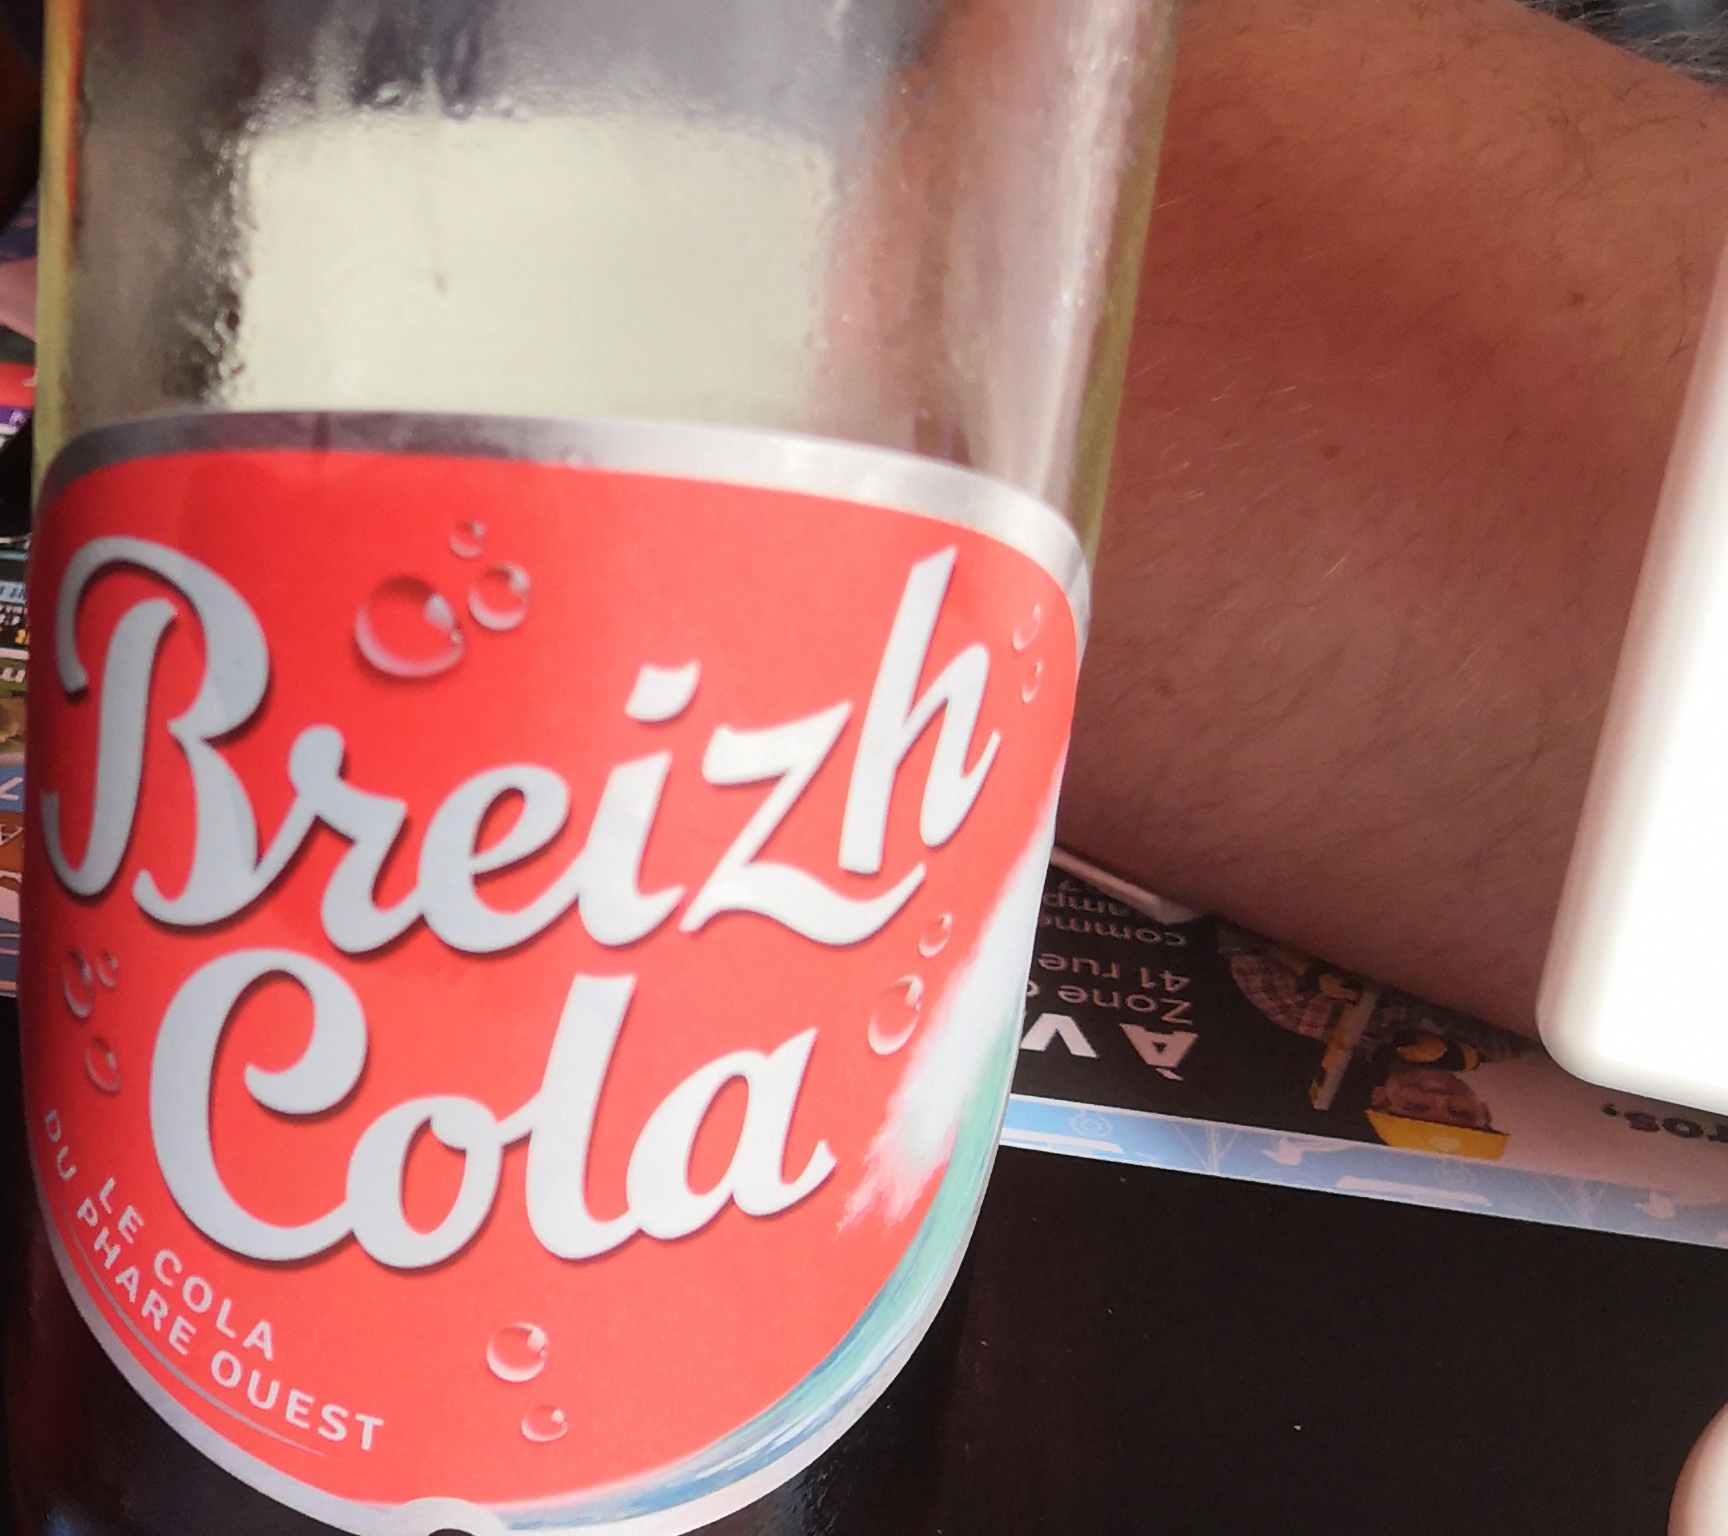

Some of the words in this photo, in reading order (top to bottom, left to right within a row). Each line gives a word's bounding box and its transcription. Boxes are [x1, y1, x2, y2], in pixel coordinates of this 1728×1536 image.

[40, 536, 1002, 955] Breizh
[1038, 953, 1120, 979] rue
[1058, 985, 1192, 1025] Zone
[1140, 967, 1190, 993] 41
[150, 947, 840, 1270] Cola
[42, 1108, 81, 1184] DU
[74, 1202, 198, 1360] PHARE
[207, 1348, 385, 1454] OUEST
[94, 1176, 147, 1248] LE
[152, 1254, 277, 1362] COLA
